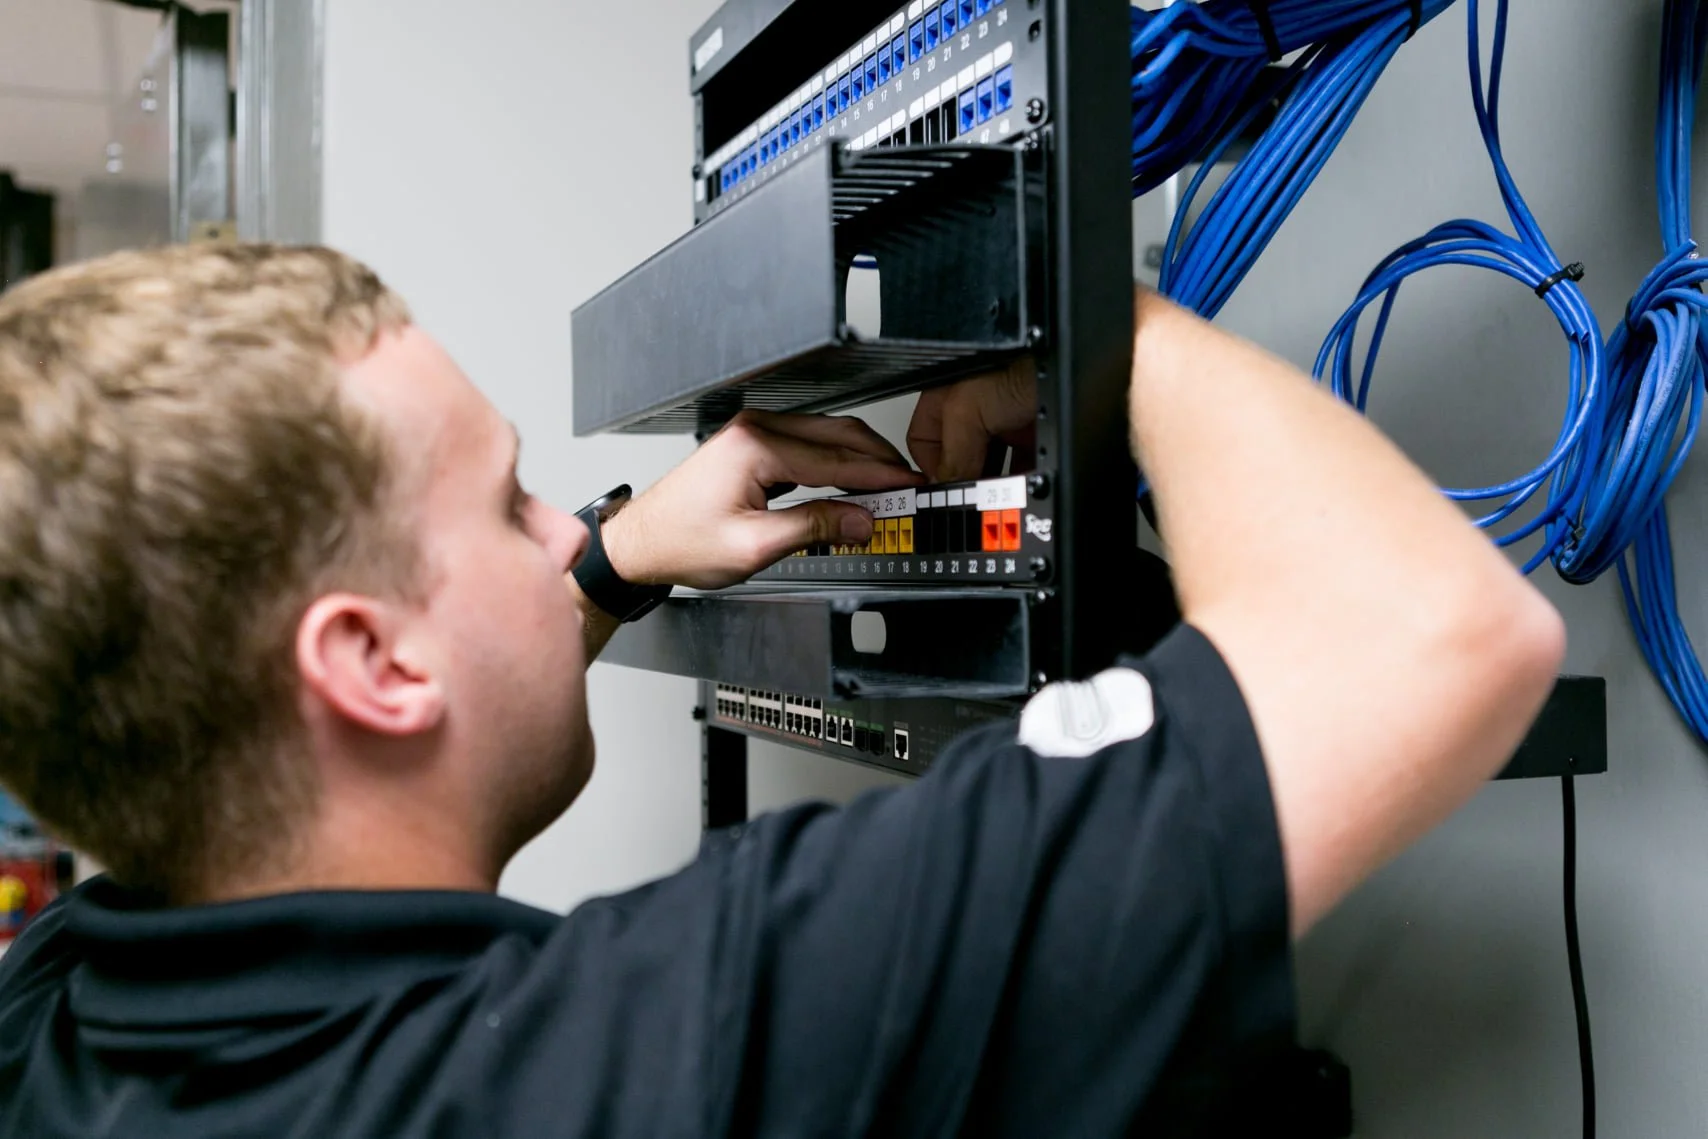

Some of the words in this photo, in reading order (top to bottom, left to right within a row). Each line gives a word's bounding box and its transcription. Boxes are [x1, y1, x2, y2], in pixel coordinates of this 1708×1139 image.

[853, 109, 860, 121] 15
[867, 101, 874, 113] 16
[880, 90, 888, 103] 17
[895, 79, 902, 93] 18
[912, 67, 920, 81] 19
[927, 56, 936, 72] 20
[943, 46, 952, 62] 21
[960, 33, 970, 51] 22
[978, 21, 988, 39] 23
[997, 8, 1008, 26] 24
[872, 499, 880, 513] 24
[885, 497, 893, 512] 25
[898, 496, 906, 510] 26
[861, 562, 867, 573] 15
[873, 562, 880, 573] 16
[887, 562, 894, 573] 17
[903, 562, 909, 573] 18
[920, 561, 928, 573] 19
[935, 561, 943, 573] 20
[951, 560, 960, 574] 21
[968, 560, 978, 574] 22
[985, 559, 996, 574] 23
[1004, 558, 1015, 574] 24
